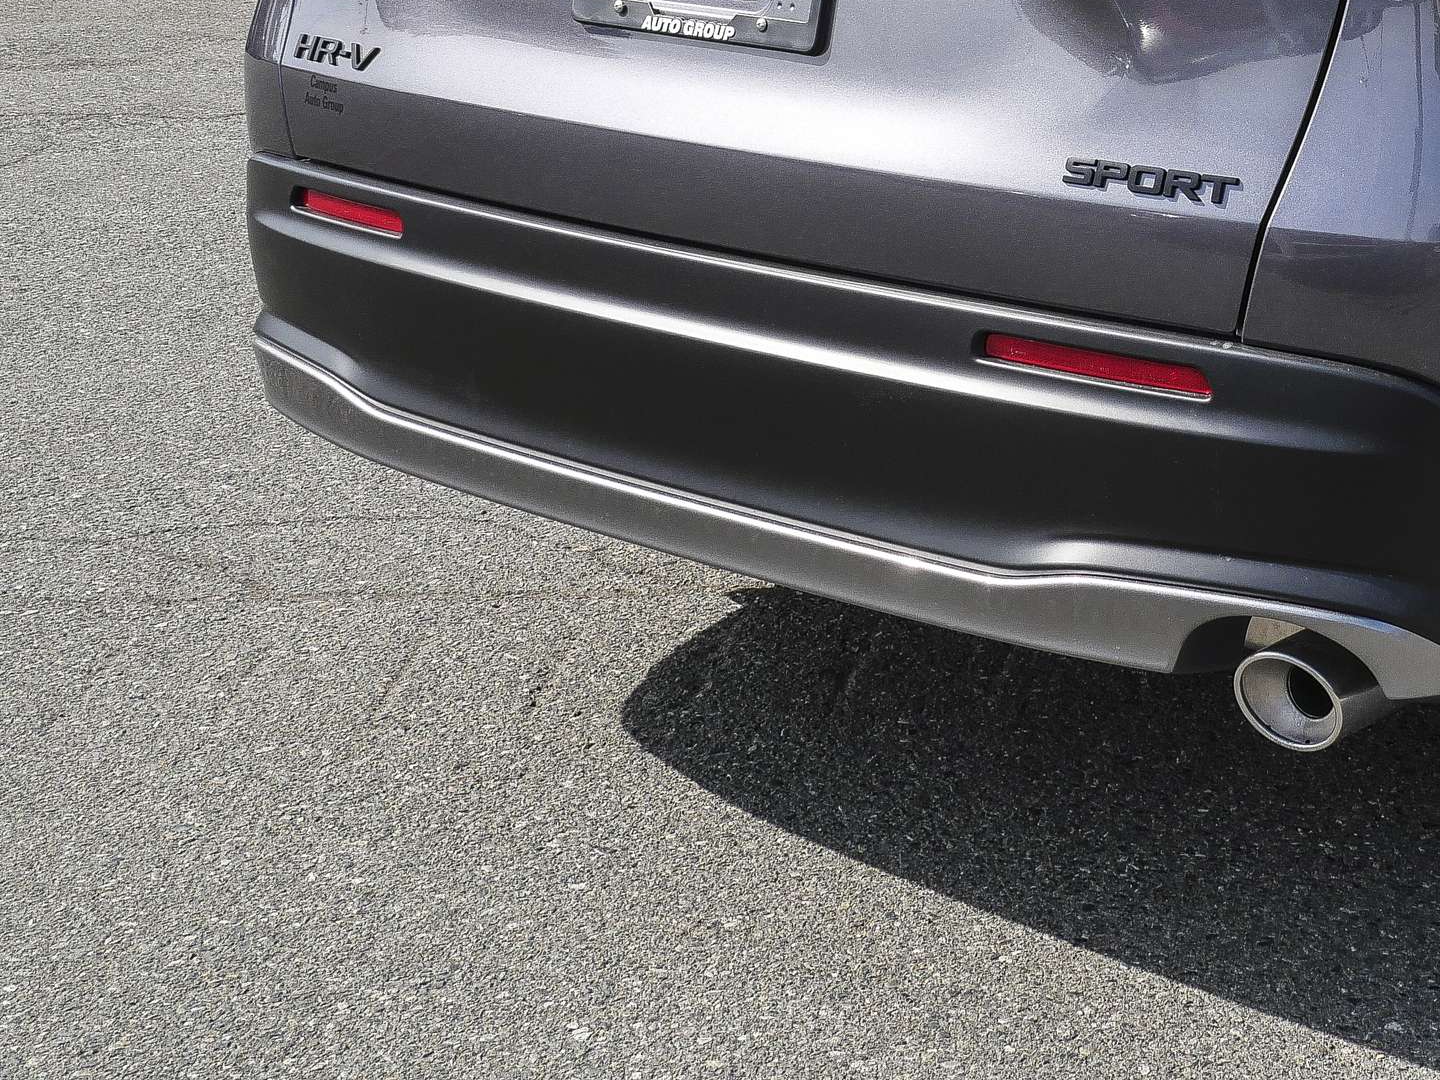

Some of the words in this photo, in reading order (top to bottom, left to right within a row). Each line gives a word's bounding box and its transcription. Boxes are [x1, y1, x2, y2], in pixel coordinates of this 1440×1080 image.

[641, 16, 682, 34] AUTO
[683, 20, 736, 41] GROUP
[293, 33, 382, 71] HR-V
[310, 74, 338, 94] Campus
[1062, 157, 1242, 207] SPORT
